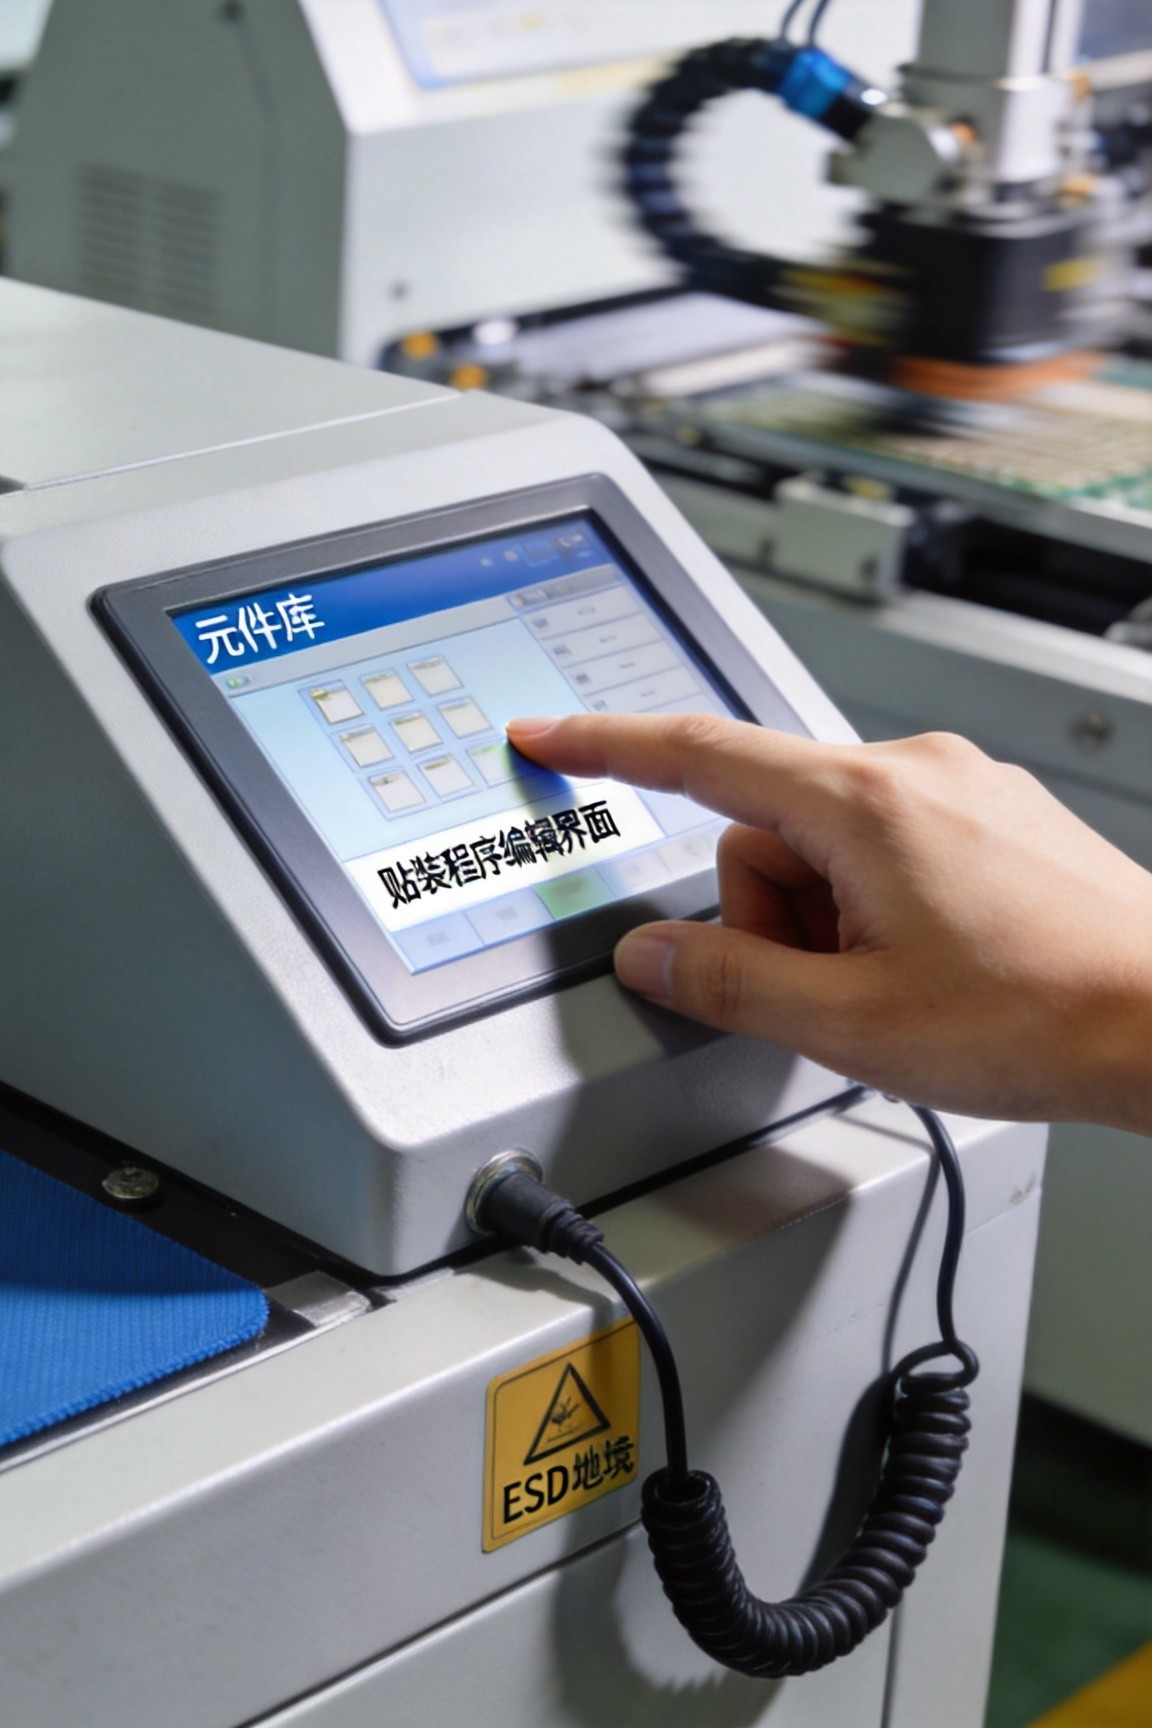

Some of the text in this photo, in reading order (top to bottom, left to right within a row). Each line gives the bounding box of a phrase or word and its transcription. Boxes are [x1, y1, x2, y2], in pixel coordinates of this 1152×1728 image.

[195, 593, 325, 664] 元件库
[377, 800, 621, 909] 贴装程序编辑界面
